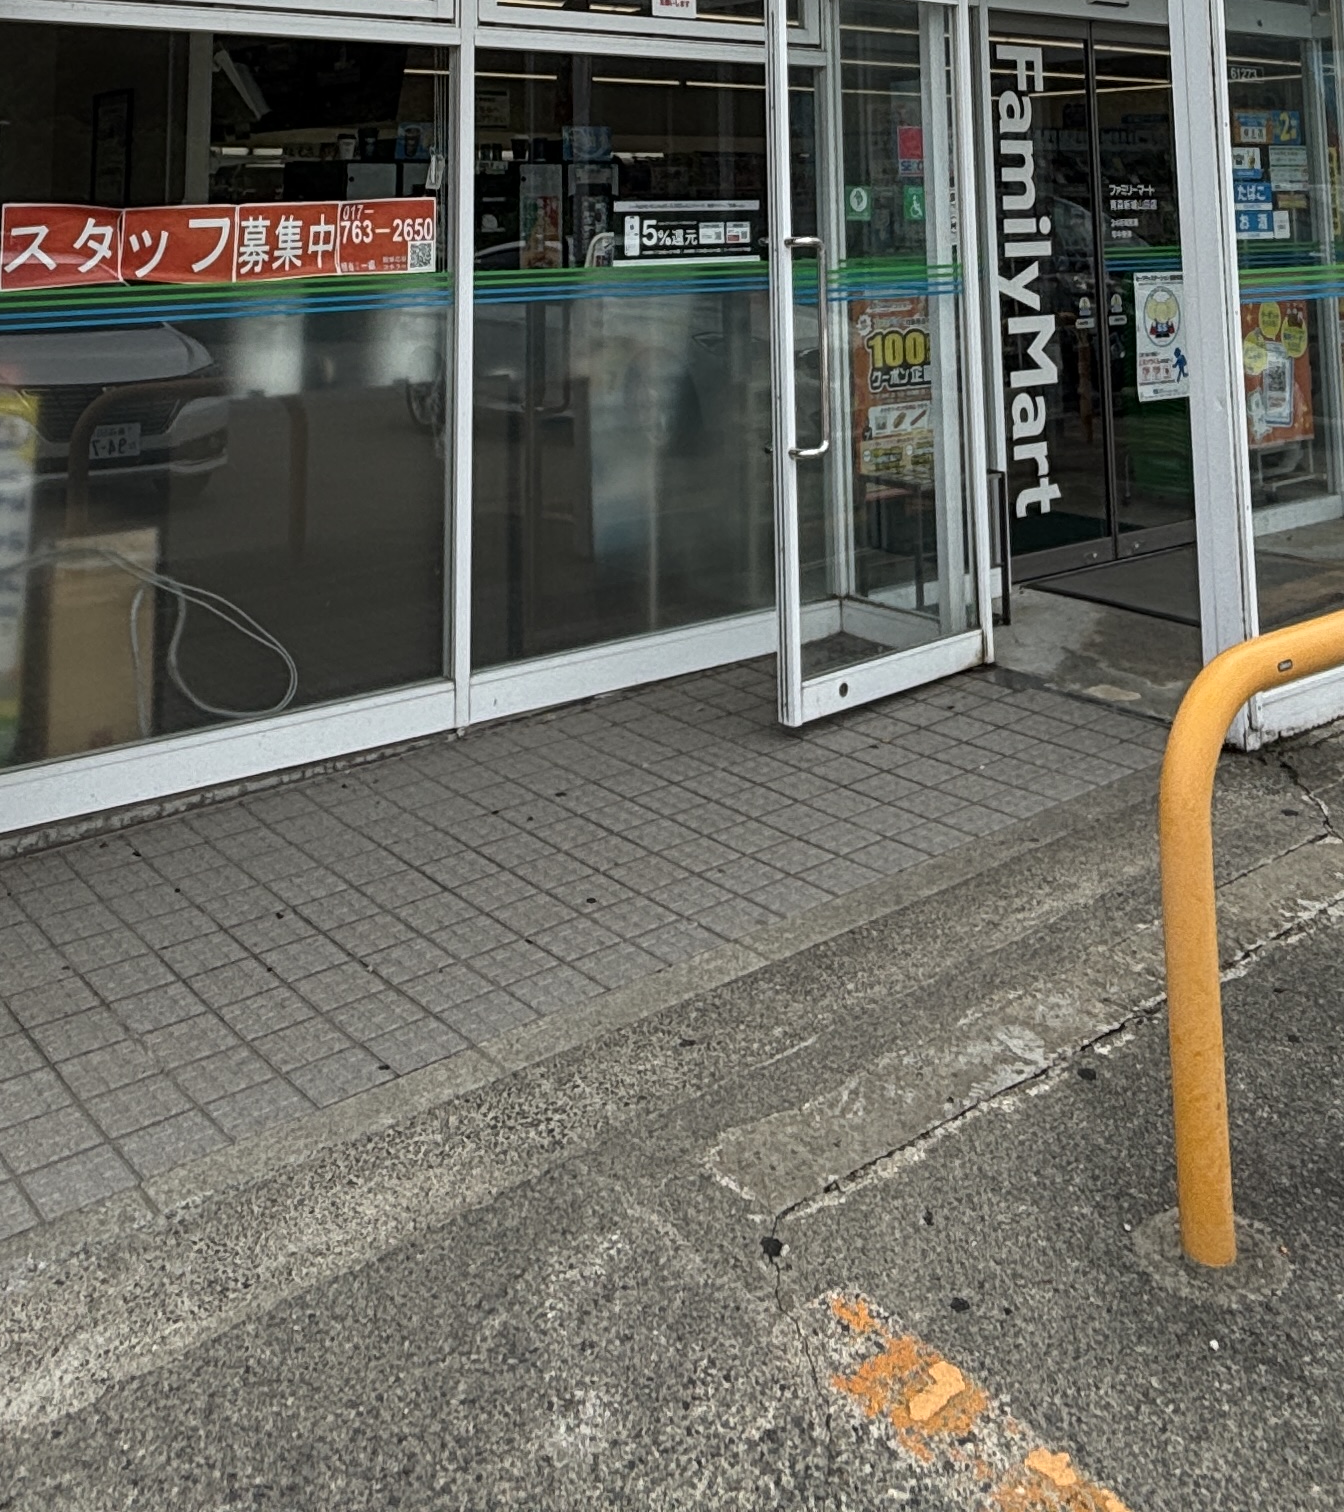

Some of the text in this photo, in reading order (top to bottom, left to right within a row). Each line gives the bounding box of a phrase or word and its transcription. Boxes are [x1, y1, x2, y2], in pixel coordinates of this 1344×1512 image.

[1237, 185, 1266, 201] たばこ
[4, 213, 336, 278] スタッフ募集中
[996, 43, 1062, 518] FamilyMart
[868, 329, 931, 369] 100
